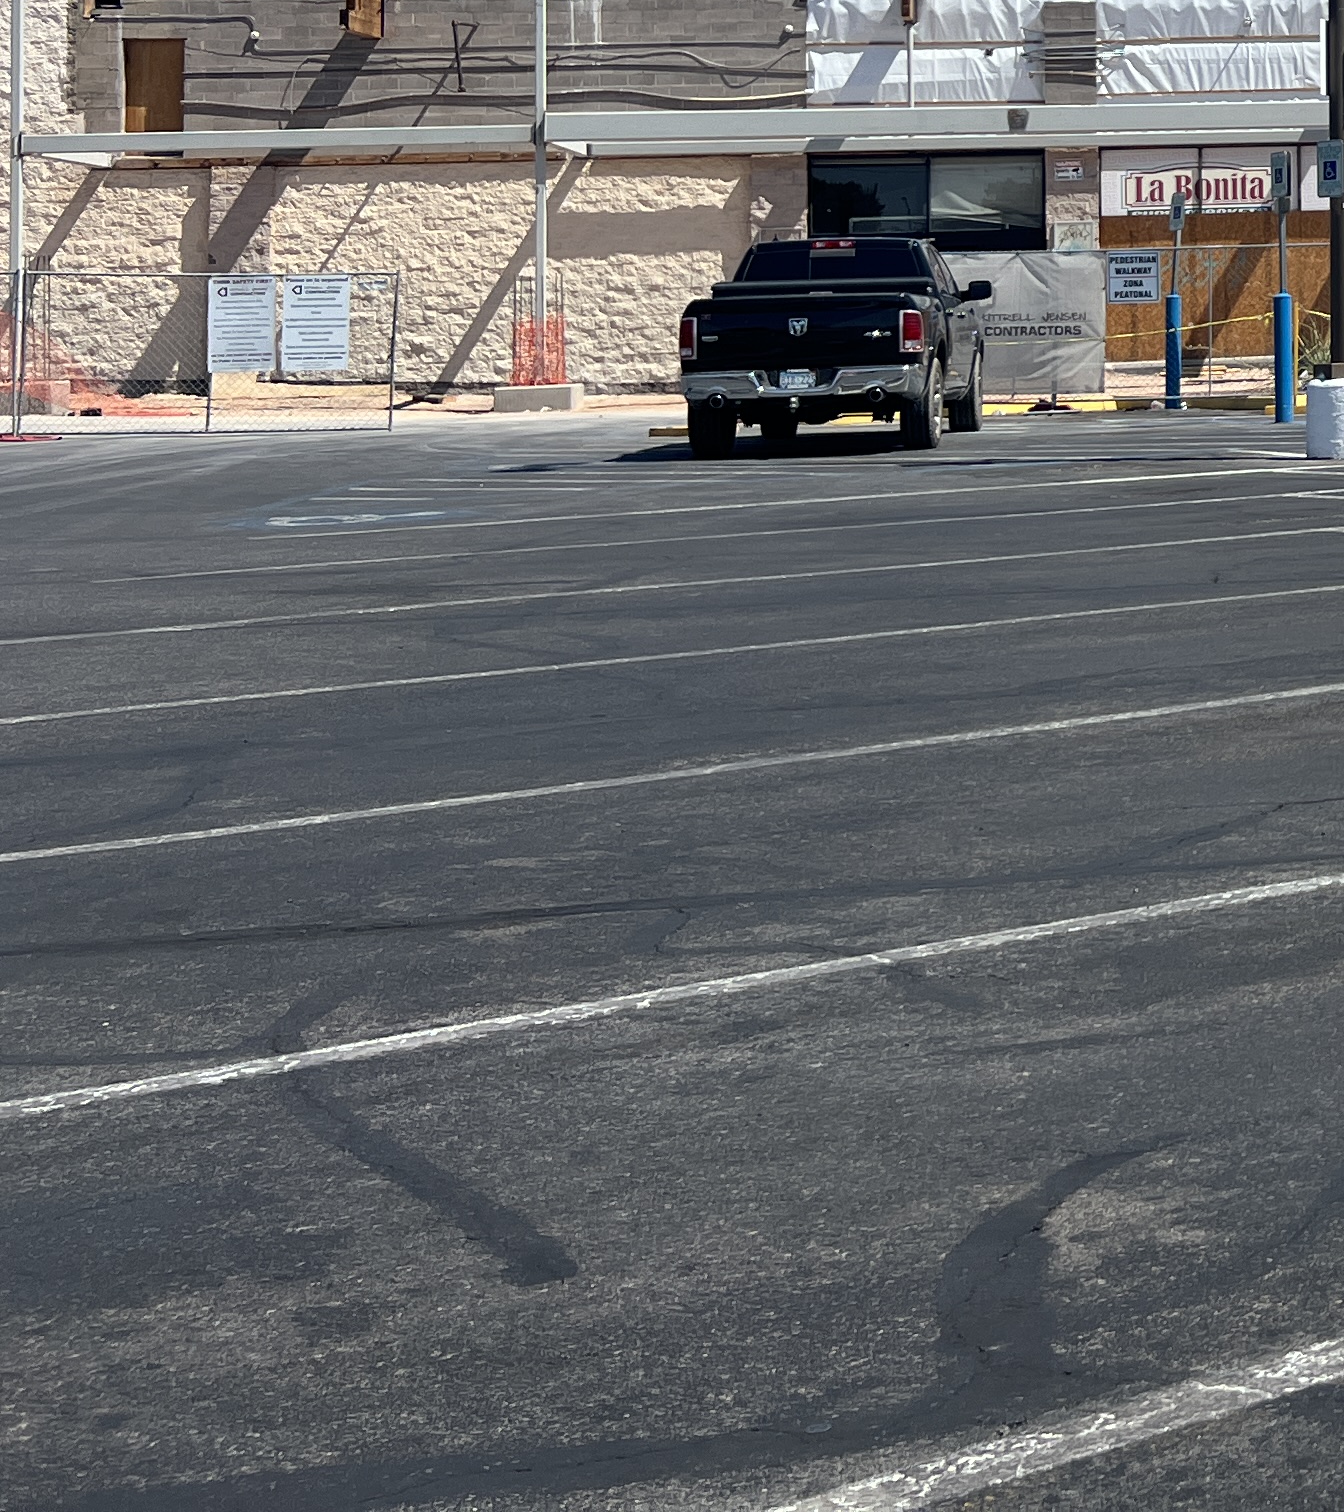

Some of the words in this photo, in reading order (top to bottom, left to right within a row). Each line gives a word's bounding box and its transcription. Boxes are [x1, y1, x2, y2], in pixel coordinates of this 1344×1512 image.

[1134, 176, 1164, 203] La
[1174, 173, 1265, 203] Bonita
[1109, 255, 1157, 264] PEDESTRIAN
[1115, 267, 1153, 276] WALKWAY
[1122, 279, 1144, 288] ZONA
[1114, 290, 1153, 299] PEATONAL
[982, 313, 1036, 323] KITTRELL
[1041, 312, 1087, 323] JENSEN
[984, 325, 1083, 337] CONTRACTORS
